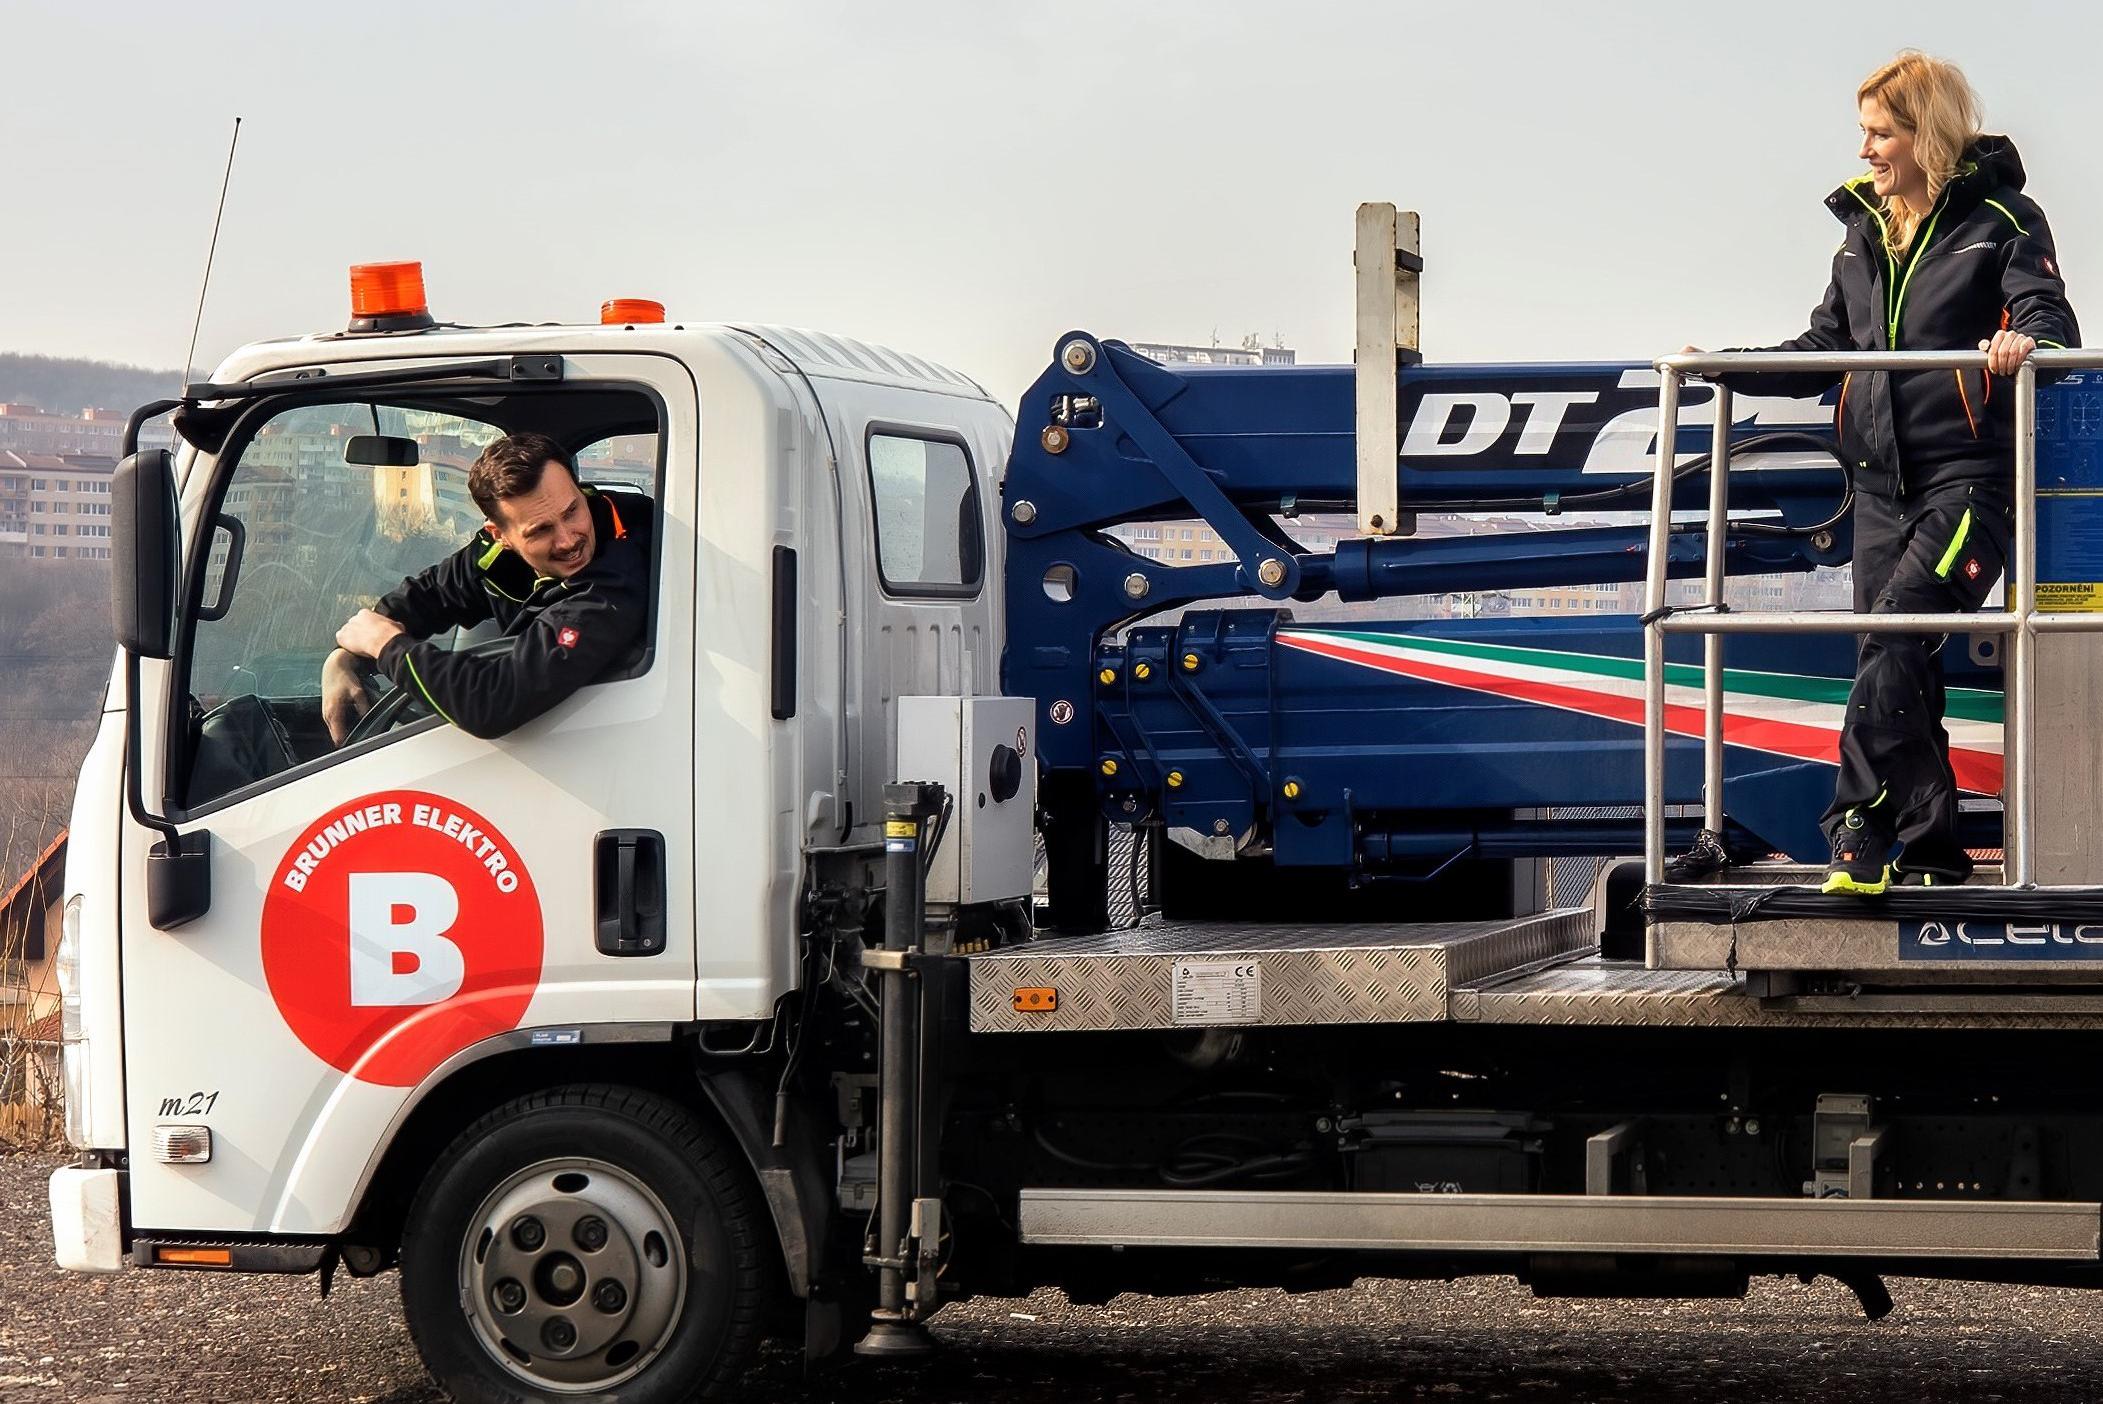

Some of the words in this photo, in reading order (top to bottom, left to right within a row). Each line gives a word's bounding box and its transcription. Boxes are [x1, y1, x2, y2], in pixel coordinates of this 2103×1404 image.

[2035, 584, 2094, 593] POZORNĚNÍ
[283, 803, 403, 893] BRUNNER
[411, 803, 519, 893] ELEKTRO
[348, 871, 465, 1007] B
[158, 1090, 220, 1116] m21
